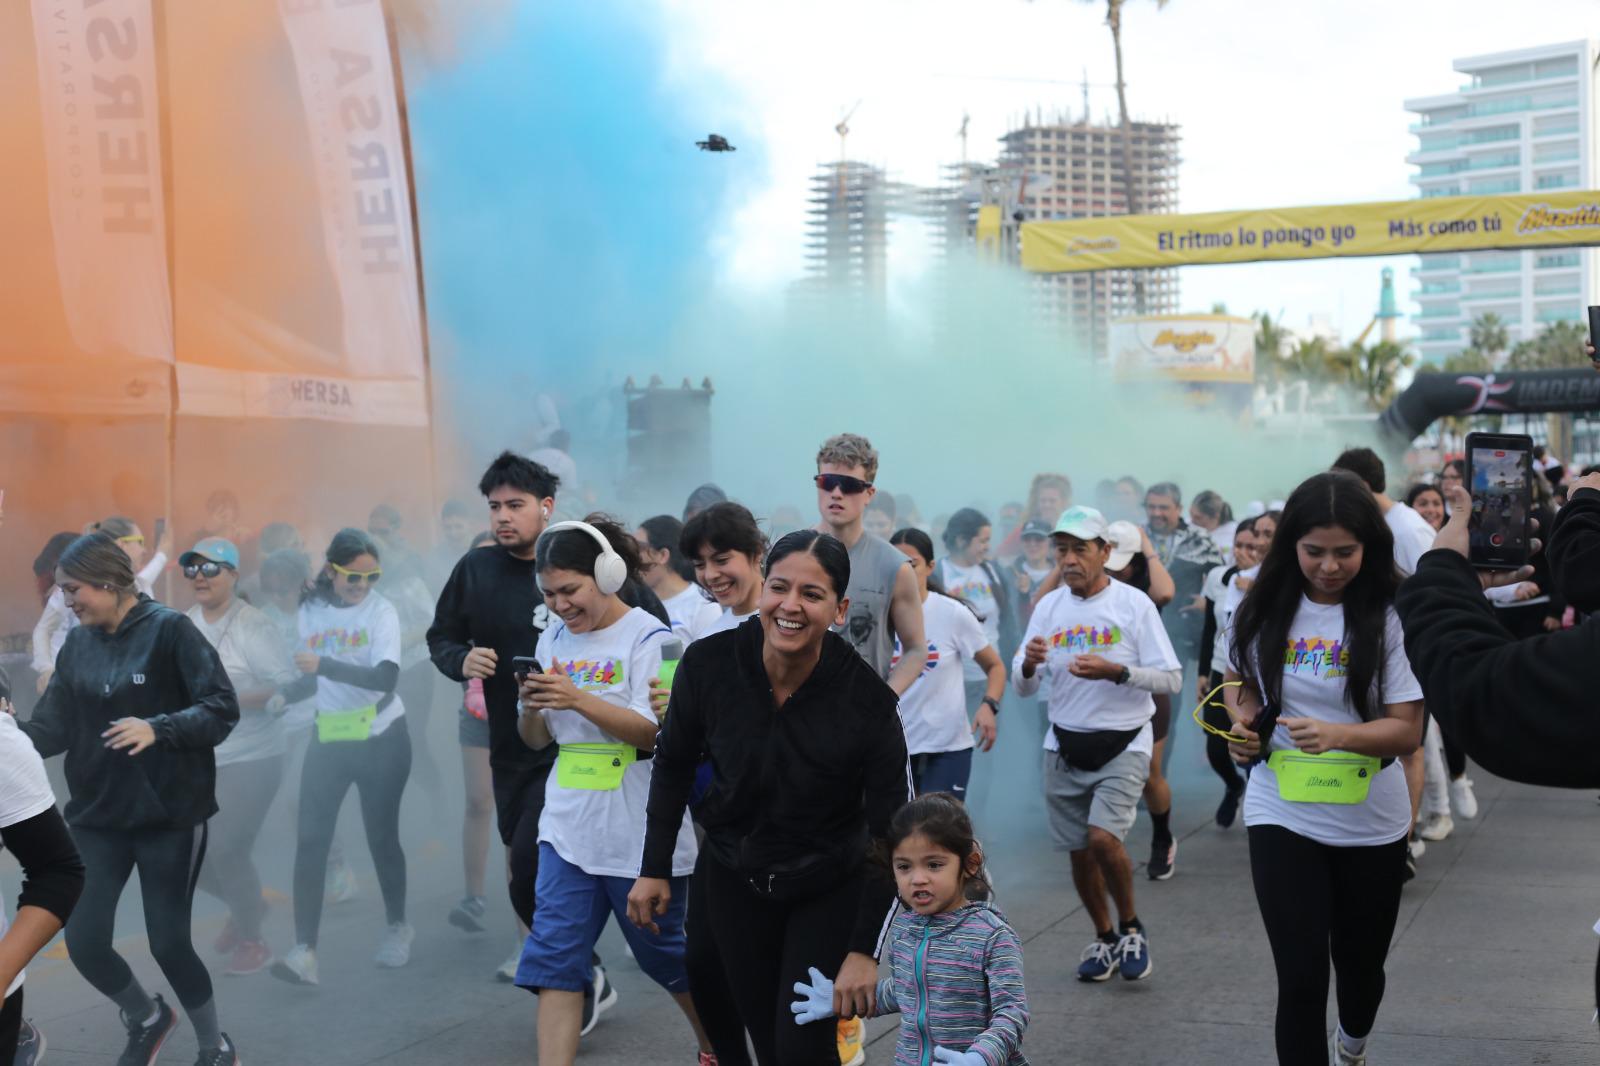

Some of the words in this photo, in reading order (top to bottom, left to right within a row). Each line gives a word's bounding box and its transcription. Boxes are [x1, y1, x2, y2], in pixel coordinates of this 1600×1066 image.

[1158, 231, 1173, 250] El
[1178, 230, 1233, 249] ritmo
[1239, 226, 1257, 246] lo
[1263, 227, 1325, 248] pongo
[1331, 224, 1356, 247] yo
[1388, 217, 1424, 238] Más
[1429, 218, 1477, 235] como
[1483, 211, 1502, 232] tú
[291, 379, 353, 407] HERSA
